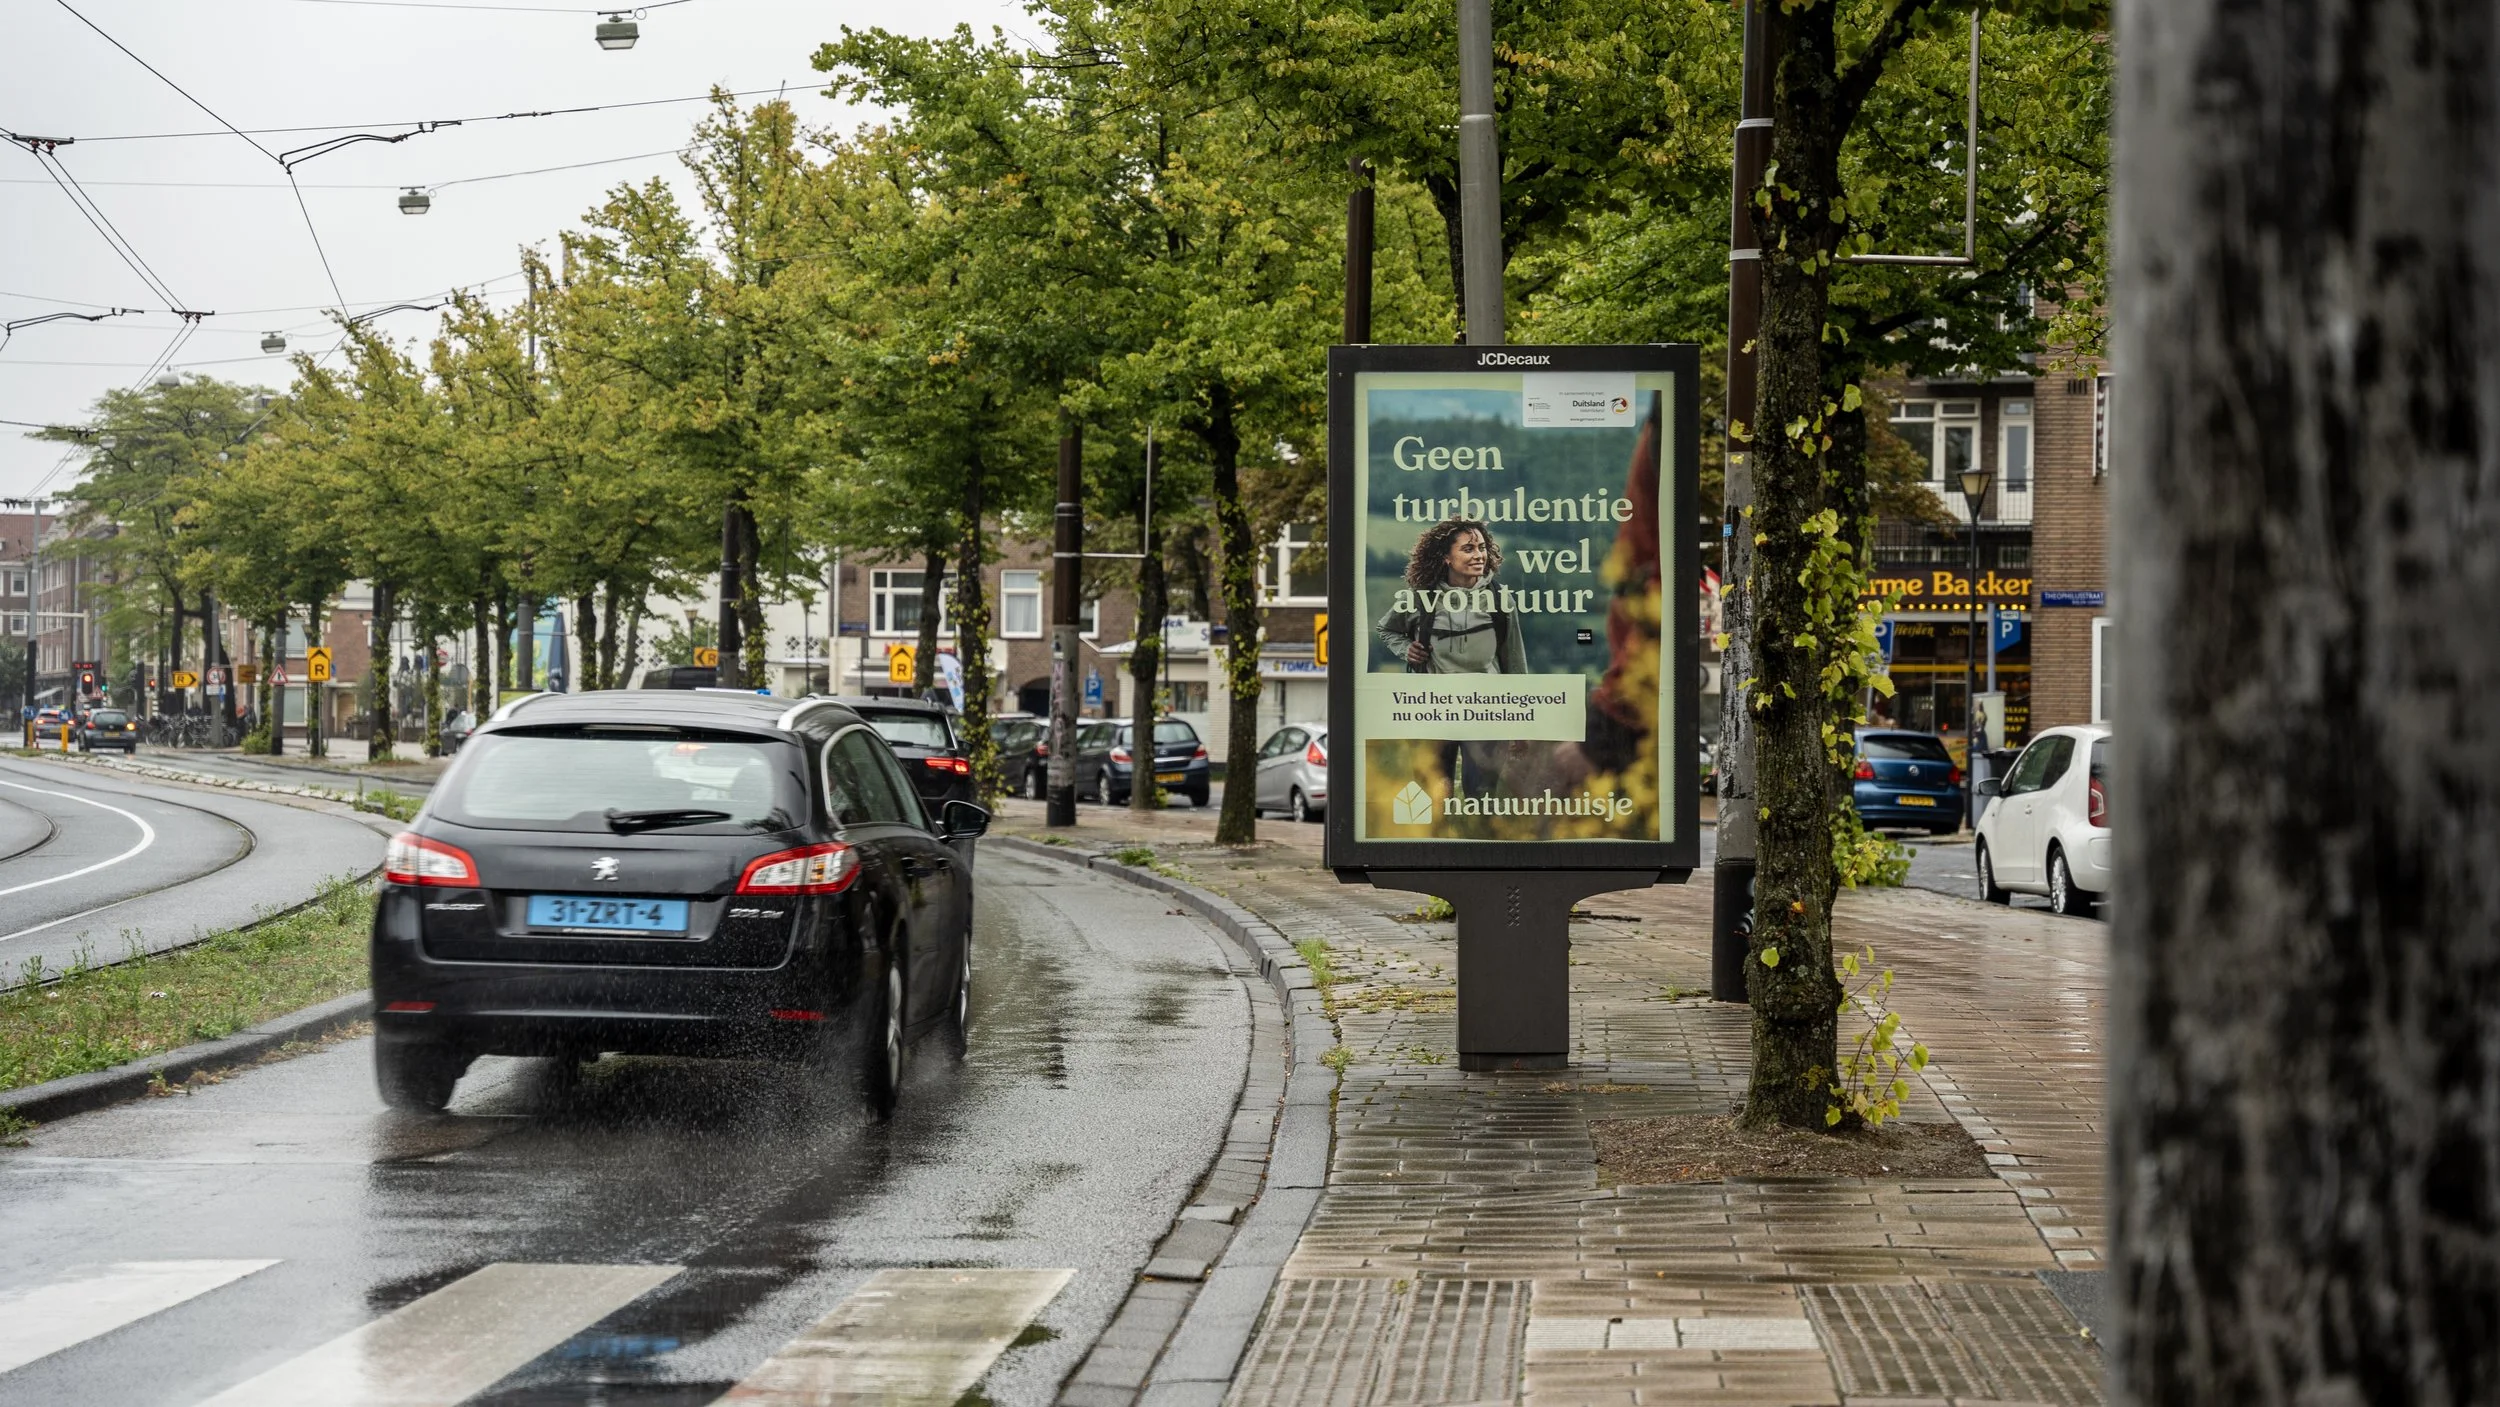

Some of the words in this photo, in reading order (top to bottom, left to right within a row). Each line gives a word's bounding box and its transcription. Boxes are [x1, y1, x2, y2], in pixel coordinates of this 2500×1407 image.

[1477, 352, 1551, 366] JCDecaux
[1393, 435, 1504, 471] Geen
[1393, 486, 1634, 523] turbulentie
[1516, 537, 1592, 574] wel
[1393, 584, 1594, 614] avontuur
[2002, 620, 2013, 639] P
[315, 664, 325, 676] R
[897, 663, 907, 676] R
[176, 675, 184, 683] R
[1088, 680, 1099, 694] P
[1392, 691, 1427, 705] Vind
[1429, 691, 1453, 705] het
[1455, 691, 1567, 708] vakantiegevoel
[1392, 711, 1412, 722] nu
[1415, 708, 1443, 722] ook
[1446, 708, 1460, 722] in
[1463, 708, 1535, 722] Duitsland
[1443, 788, 1633, 822] natuurhuisje
[550, 899, 664, 926] 31-ZRT-4
